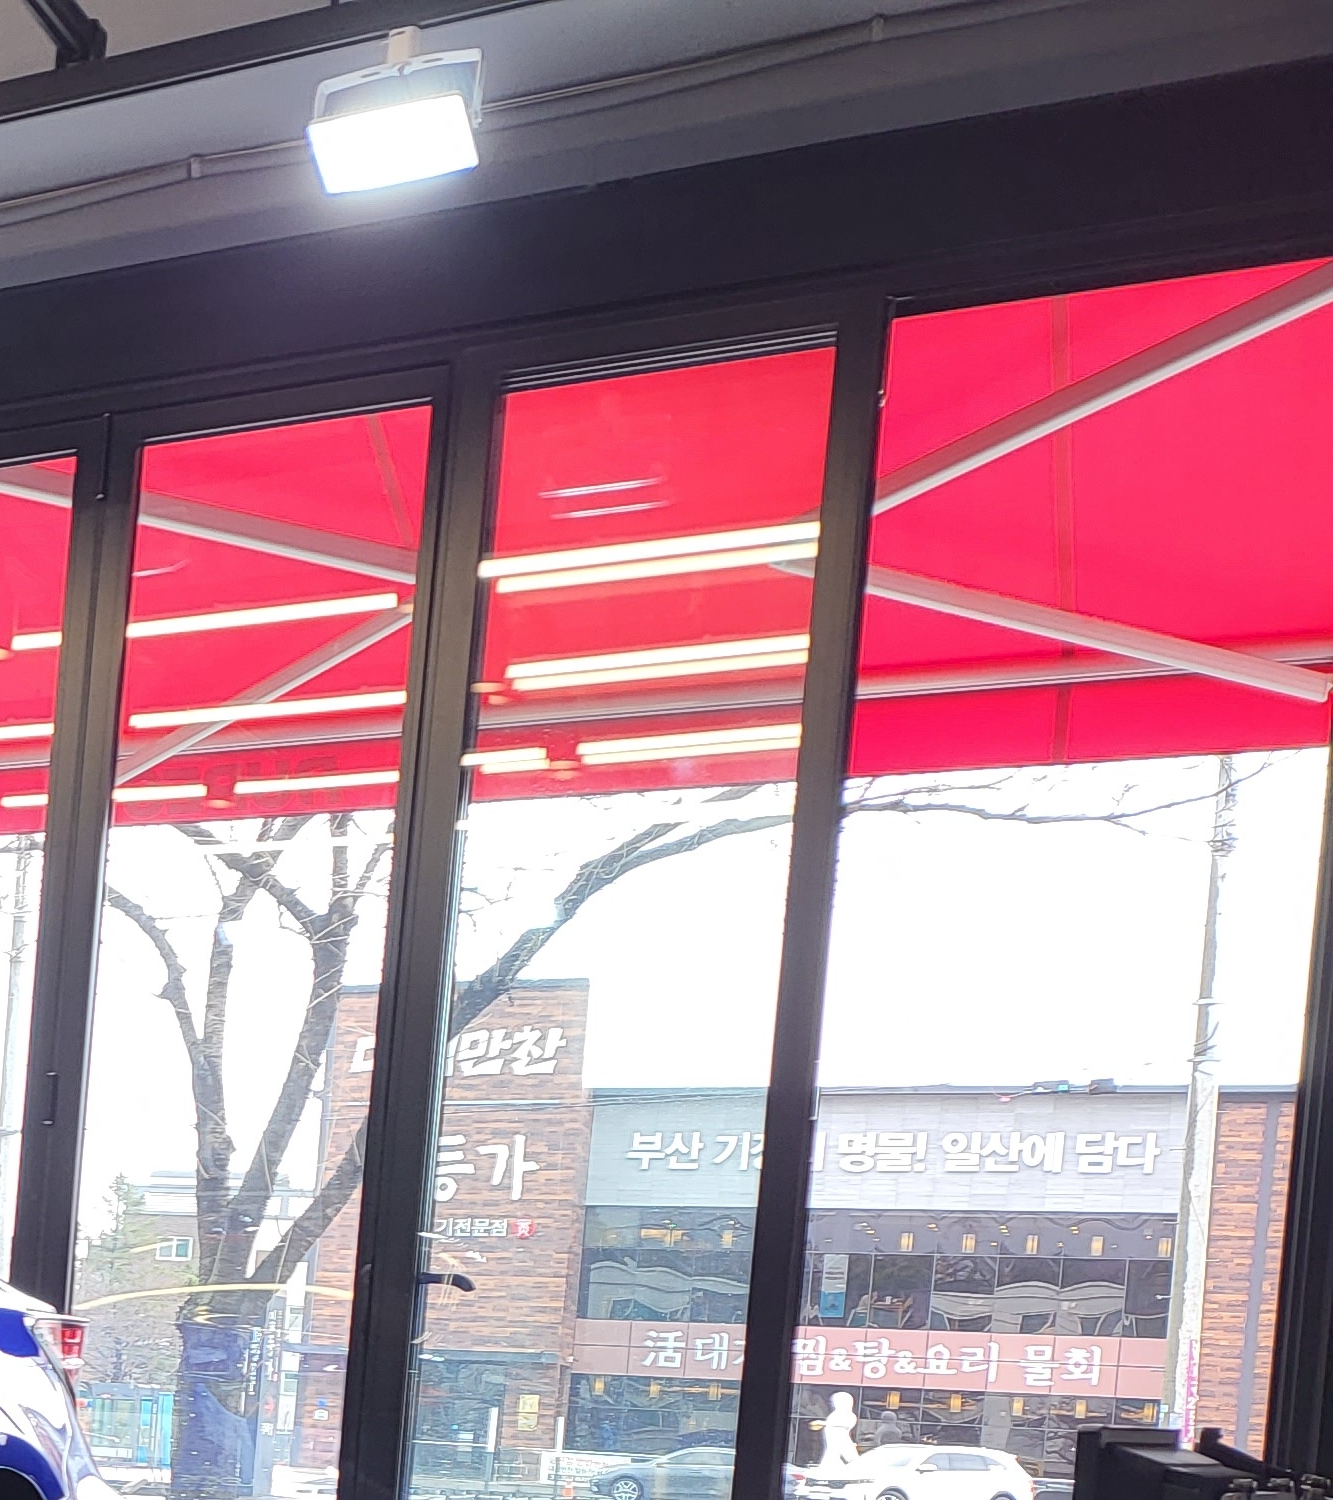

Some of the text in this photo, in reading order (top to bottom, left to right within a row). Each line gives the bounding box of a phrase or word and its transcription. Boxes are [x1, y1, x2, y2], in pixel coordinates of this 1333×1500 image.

[625, 1130, 705, 1171] 부산
[836, 1131, 928, 1174] 명물!
[939, 1130, 1065, 1173] 일산에
[1073, 1131, 1161, 1174] 담다
[1017, 1343, 1102, 1387] 물회
